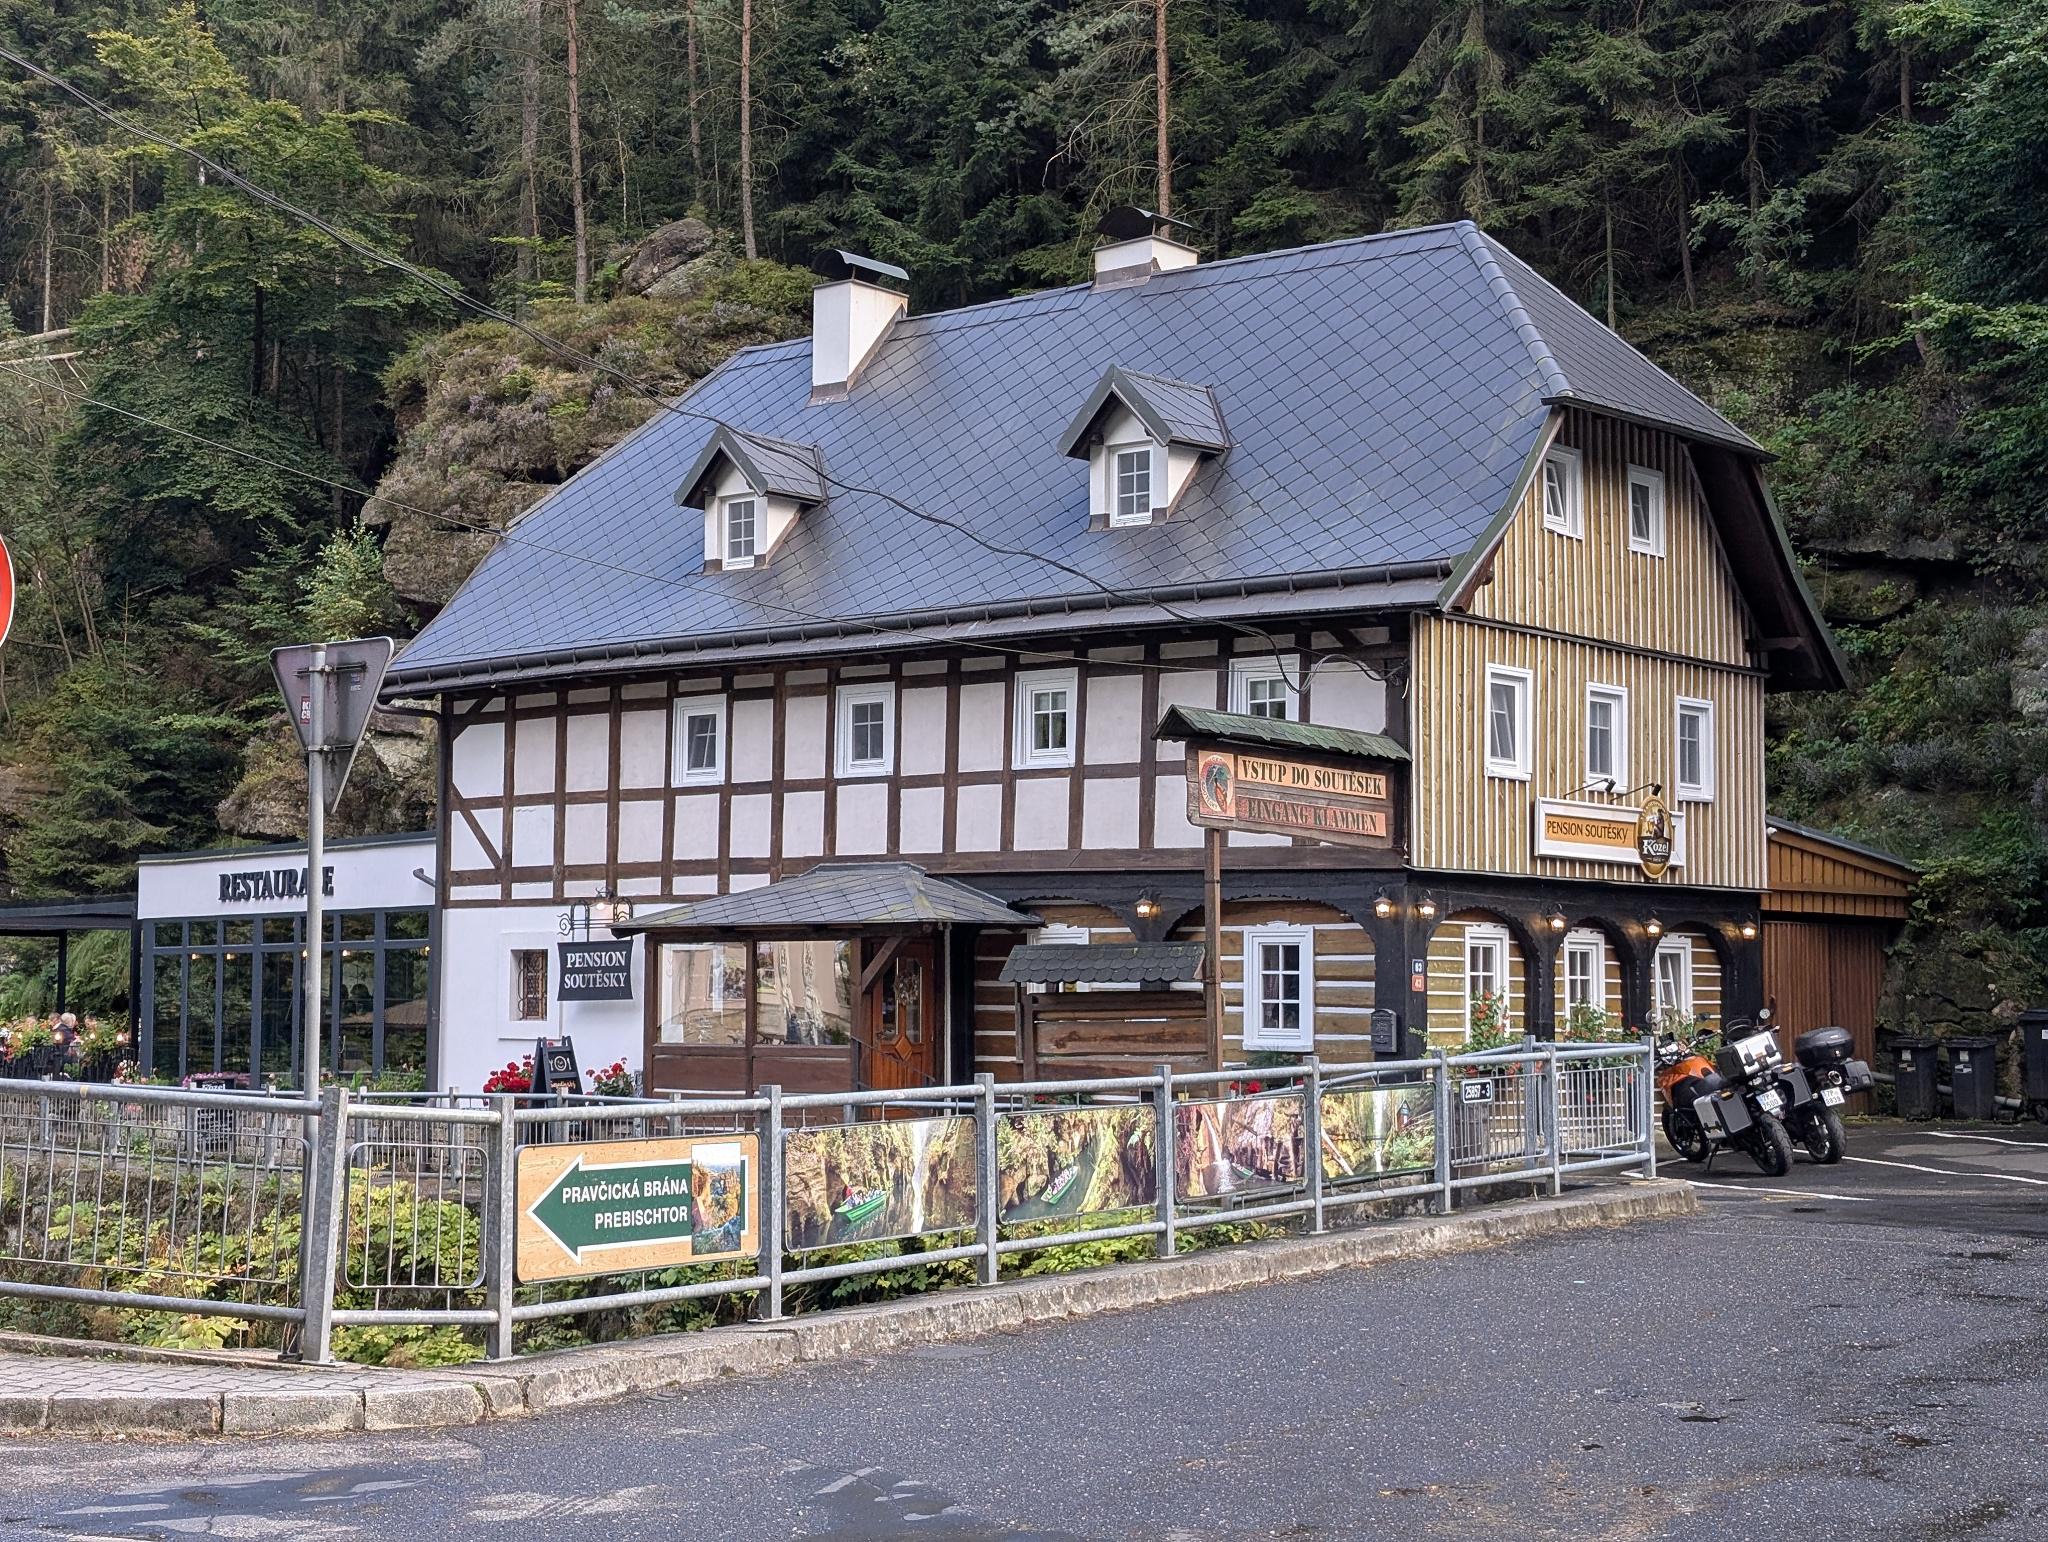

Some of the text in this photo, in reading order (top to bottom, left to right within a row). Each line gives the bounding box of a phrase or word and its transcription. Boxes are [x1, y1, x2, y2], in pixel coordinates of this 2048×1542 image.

[1242, 759, 1382, 796] VSTUP DO SOUTĚSEK
[1247, 799, 1309, 824] EINGANG
[1546, 820, 1629, 844] PENSION SOUTĚSKY
[1642, 838, 1669, 856] Kozel
[218, 865, 335, 902] RESTAURAE
[566, 951, 627, 968] PENSION
[563, 969, 627, 989] SOUTĚSKY
[562, 1176, 689, 1204] PRAVČICKÁ BRÁNA
[594, 1205, 688, 1230] PREBISCHTOR
